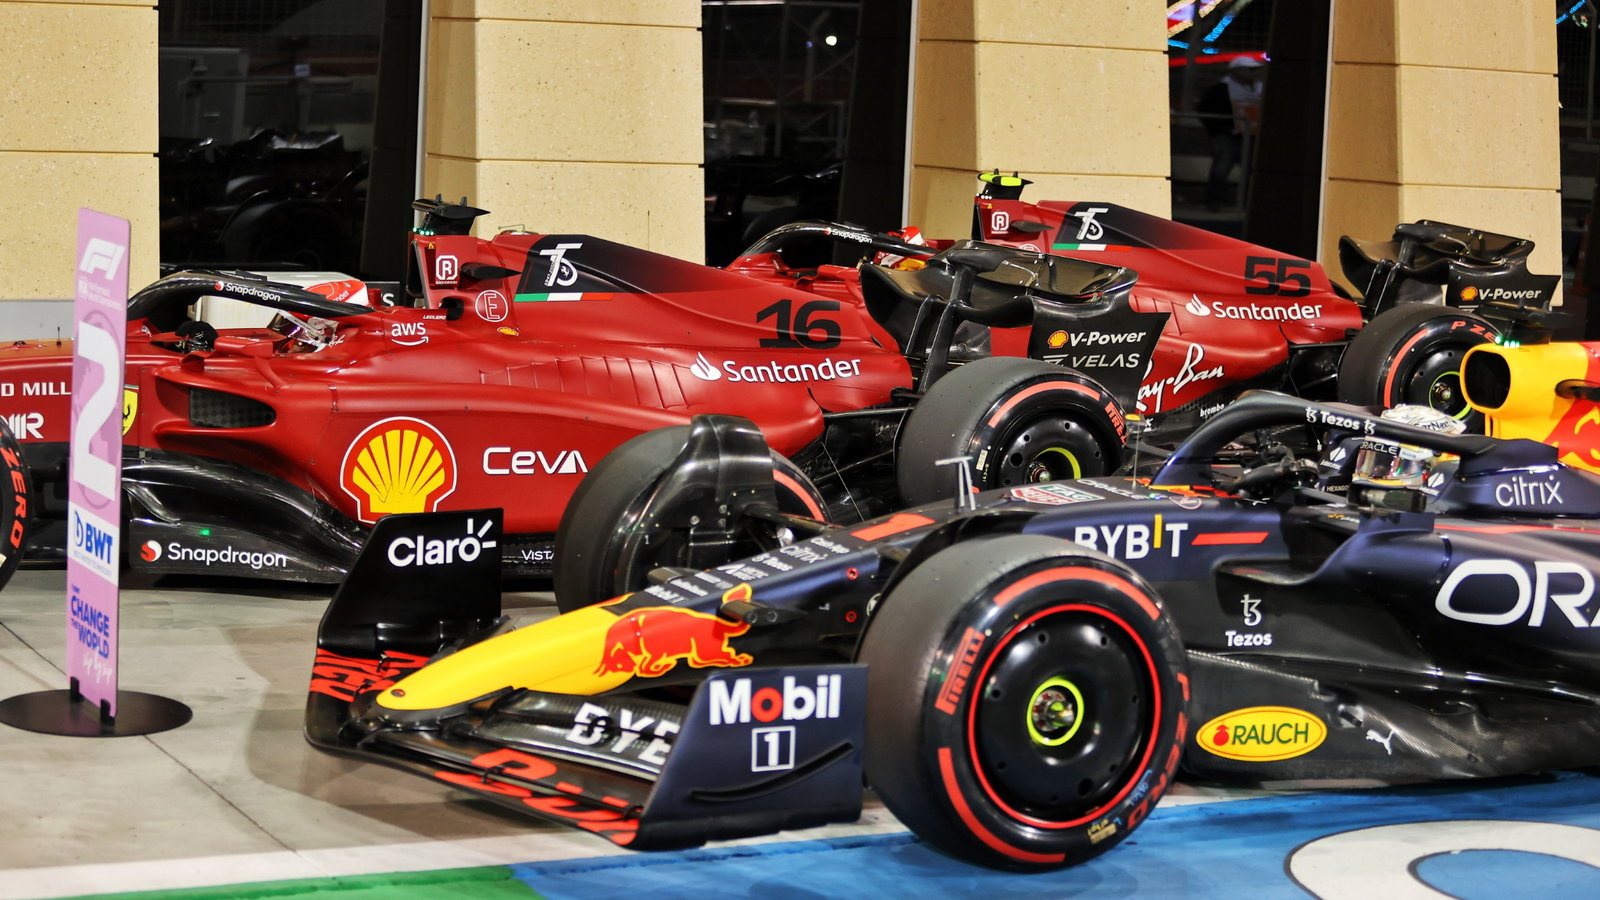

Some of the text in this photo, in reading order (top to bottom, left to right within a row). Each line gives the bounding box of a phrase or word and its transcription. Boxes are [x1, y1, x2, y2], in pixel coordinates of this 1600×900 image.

[832, 229, 872, 243] Snapdragon
[1244, 256, 1312, 297] 55
[225, 281, 281, 302] Snapdragon
[1478, 288, 1542, 300] V-Power
[756, 299, 841, 349] 16
[1212, 301, 1322, 323] Santander
[391, 322, 427, 337] aws
[1070, 331, 1147, 347] V-Power
[1469, 323, 1497, 344] ZE
[723, 358, 861, 383] Santander
[1072, 352, 1141, 368] VELAS
[22, 382, 72, 396] MILL
[74, 321, 120, 502] 2
[1200, 402, 1225, 418] brembo
[1320, 410, 1361, 430] Tezos
[1104, 401, 1129, 446] PIREL
[0, 446, 27, 550] ZERO
[1326, 485, 1350, 493] HEXAGO
[1495, 475, 1564, 507] citrix
[85, 521, 114, 566] BWT
[1074, 513, 1189, 559] BYBIT
[167, 543, 288, 570] Snapdragon
[387, 534, 481, 568] Claro
[1435, 559, 1600, 629] OR
[71, 594, 110, 639] CHANGE
[1224, 630, 1273, 647] Tezos
[934, 626, 986, 716] PIRELLI
[708, 673, 842, 726] Mobil
[1230, 722, 1309, 746] RAUCH
